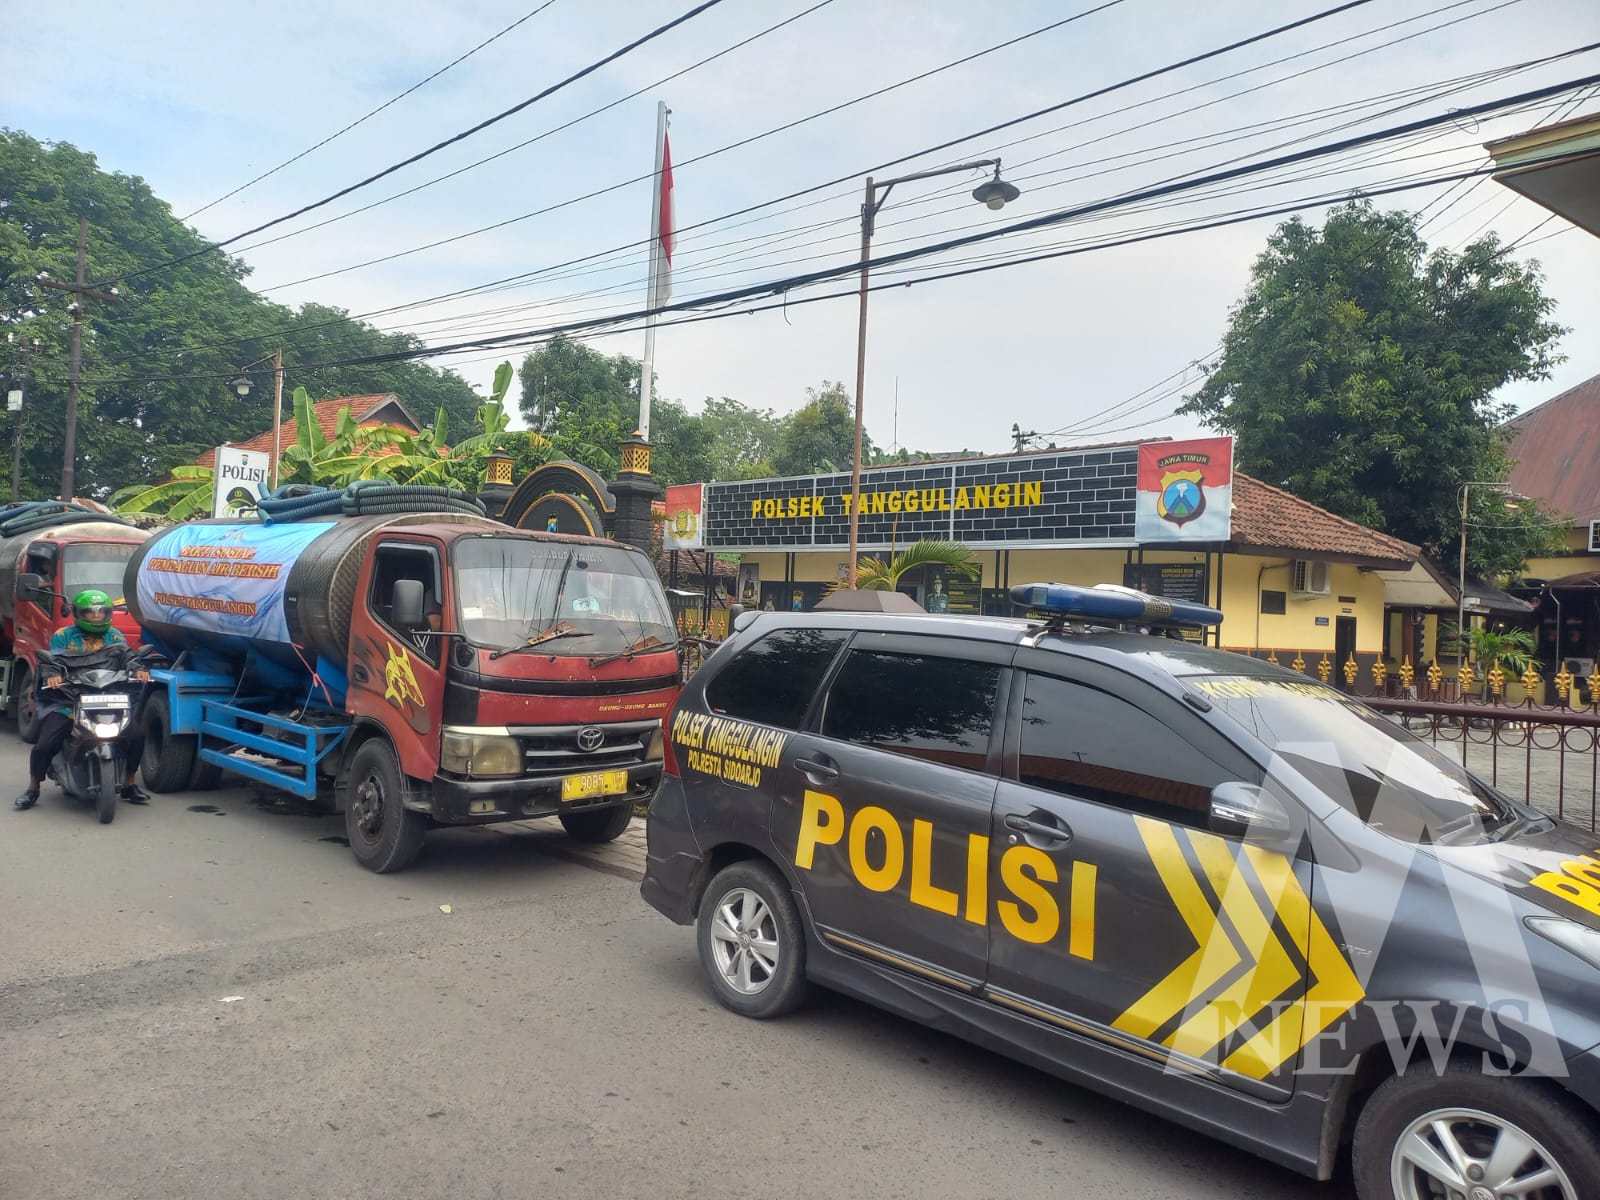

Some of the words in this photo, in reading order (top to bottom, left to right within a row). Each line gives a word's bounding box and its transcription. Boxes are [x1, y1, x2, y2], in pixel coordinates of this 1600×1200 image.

[222, 464, 265, 483] POLISI
[1160, 455, 1182, 467] JAWA
[1183, 454, 1208, 465] TIMUR
[751, 496, 825, 519] POLSEK
[842, 480, 1042, 516] TANGGULANGIN
[231, 563, 282, 579] BERSIH
[672, 709, 712, 750] POLSEK
[706, 717, 788, 769] TANGGULANGIN
[687, 749, 722, 778] POLRESTA
[723, 759, 761, 789] SIDOARJO
[795, 789, 1097, 961] POLISI
